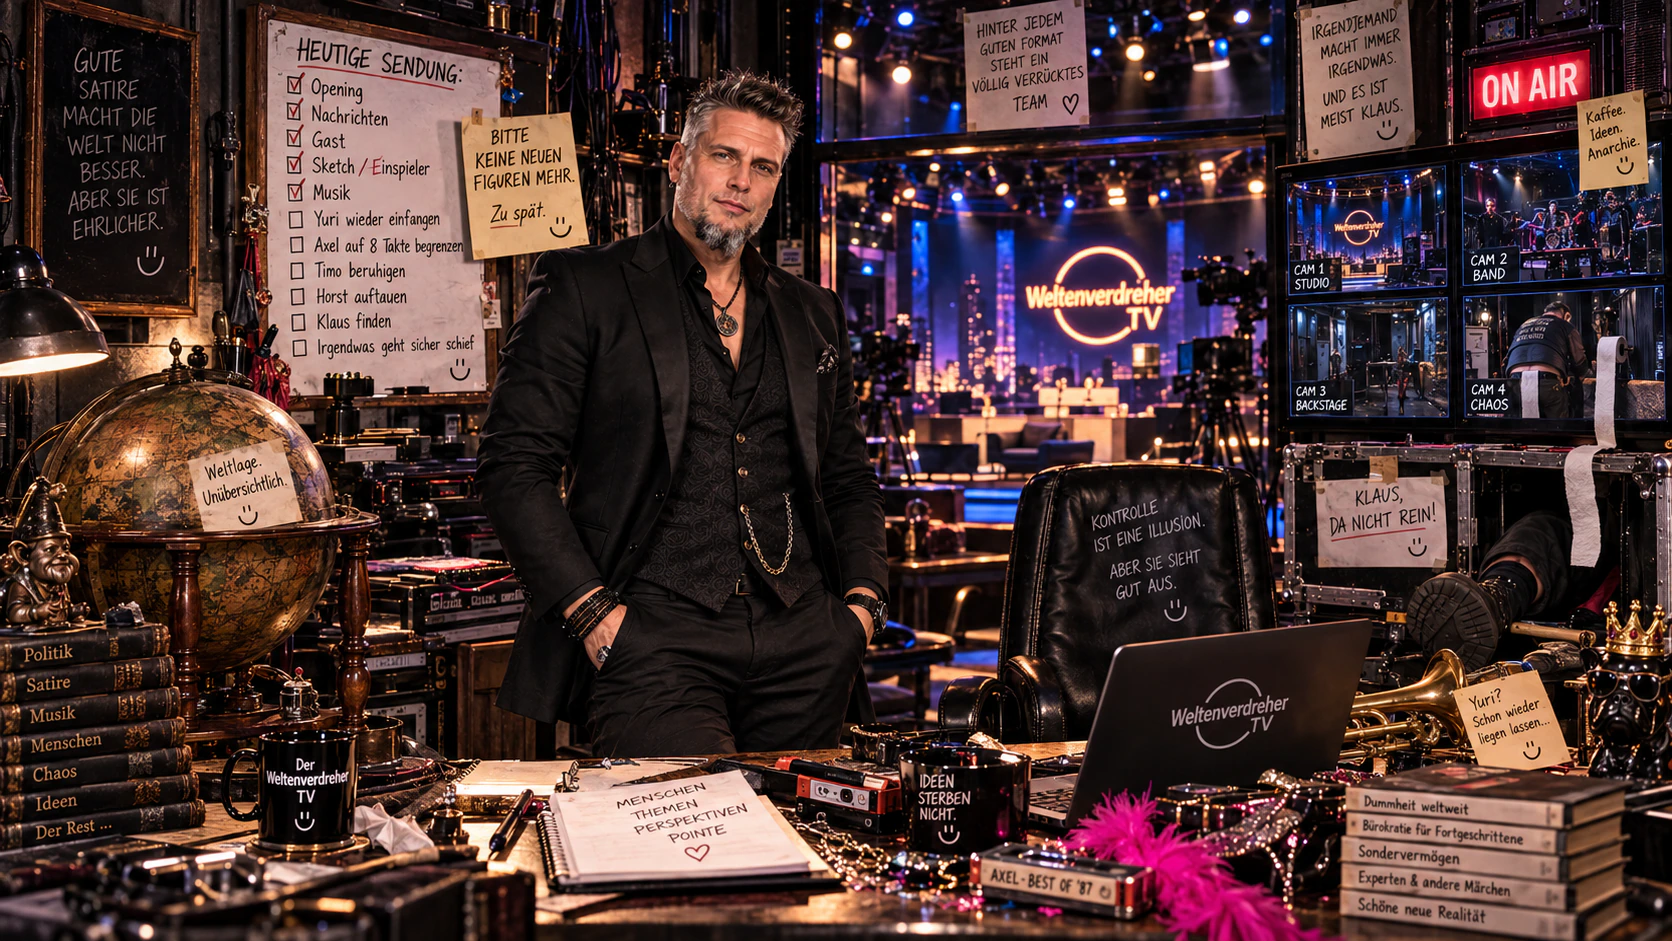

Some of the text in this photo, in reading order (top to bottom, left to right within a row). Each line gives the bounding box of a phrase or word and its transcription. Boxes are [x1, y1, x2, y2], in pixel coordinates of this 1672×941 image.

[977, 11, 1064, 39] HINTER JEDEM
[1311, 7, 1398, 41] IRGENDJEMAND
[980, 32, 1064, 56] GUTEN FORMAT
[1320, 27, 1401, 60] MACHT IMMER
[74, 47, 124, 73] GUTE
[297, 37, 463, 84] HEUTIGE SENDUNG:
[990, 52, 1049, 72] STEHT EIN
[1328, 51, 1397, 80] IRGENDWAS.
[79, 79, 139, 100] SATIRE
[972, 65, 1084, 93] VÖLLIG VERRÜCKTES
[1482, 62, 1579, 109] ON AIR
[311, 78, 363, 104] Opening
[1322, 78, 1388, 107] UND ES IST
[1013, 94, 1048, 112] TEAM
[63, 106, 157, 129] MACHT DIE
[311, 105, 389, 127] Nachrichten
[1320, 99, 1403, 130] MEIST KLAUS.
[1585, 105, 1626, 126] Kaffee.
[312, 131, 346, 149] Gast
[491, 127, 529, 145] BITTE
[1590, 123, 1623, 143] Ideen.
[67, 134, 166, 156] WELT NICHT
[1587, 136, 1640, 162] Anarchie.
[312, 157, 355, 174] Sketch
[475, 147, 562, 169] KEINE NEUEN
[80, 159, 145, 183] BESSER.
[473, 167, 575, 191] FIGUREN MEHR.
[67, 186, 170, 215] ABER SIE IST
[313, 184, 351, 201] Musik
[314, 211, 440, 231] Yuri wieder einfangen
[490, 201, 546, 227] Zu spät.
[73, 211, 164, 240] EHRLICHER.
[314, 236, 464, 257] Axel auf 8 Takte begrenzen
[1294, 262, 1325, 276] CAM 1
[1471, 252, 1508, 267] CAM 2
[315, 262, 406, 282] Timo beruhigen
[1473, 267, 1506, 281] BAND
[1026, 279, 1176, 309] Weltenverdreher
[1294, 277, 1330, 290] STUDIO
[317, 288, 407, 304] Horst auftauen
[317, 313, 391, 330] Klaus finden
[1126, 305, 1163, 331] TV
[317, 334, 475, 359] Irgendwas geht sicher schief
[1295, 385, 1327, 397] CAM 3
[1471, 383, 1506, 396] CAM 4
[1295, 398, 1348, 412] BACKSTAGE
[1470, 398, 1509, 411] CHAOS
[204, 457, 262, 481] Weltlage.
[202, 471, 287, 506] Unübersichtlich.
[1355, 486, 1403, 507] KLAUS,
[1091, 499, 1158, 531] KONTROLLE
[1329, 501, 1436, 537] DA NICHT REIN!
[1093, 534, 1111, 553] IST
[1116, 526, 1143, 547] EINE
[1109, 549, 1201, 579] ABER SIE SIEHT
[1115, 575, 1177, 600] GUT AUS.
[23, 644, 73, 663] Politik
[26, 676, 71, 693] Satire
[1468, 687, 1502, 711] Yuri?
[30, 705, 76, 724] Musik
[1171, 695, 1289, 727] Weltenverdreher
[1472, 700, 1540, 728] Schon wieder
[1250, 715, 1274, 733] TV
[1477, 718, 1550, 746] liegen lassen...
[31, 733, 102, 754] Menschen
[32, 766, 78, 783] Chaos
[295, 758, 316, 771] Der
[266, 769, 350, 786] Weltenverdreher
[919, 773, 955, 789] IDEEN
[36, 795, 78, 812] Ideen
[296, 789, 316, 804] TV
[616, 782, 707, 810] MENSCHEN
[918, 790, 971, 805] STERBEN
[1364, 795, 1469, 816] Dummheit weltweit
[630, 799, 699, 821] THEMEN
[633, 803, 748, 835] PERSPEKTIVEN
[919, 807, 957, 821] NICHT.
[36, 824, 63, 841] Der
[66, 820, 96, 836] Rest
[667, 823, 728, 844] POINTE
[1362, 819, 1524, 846] Bürokratie für Fortgeschrittene
[1358, 845, 1460, 866] Sondervermögen
[990, 868, 1019, 885] AXEL
[1028, 873, 1056, 892] BEST
[1059, 878, 1073, 893] OF
[1076, 879, 1093, 895] '87
[1358, 871, 1511, 898] Experten & andere Märchen
[1357, 897, 1487, 924] Schöne neue Realität
